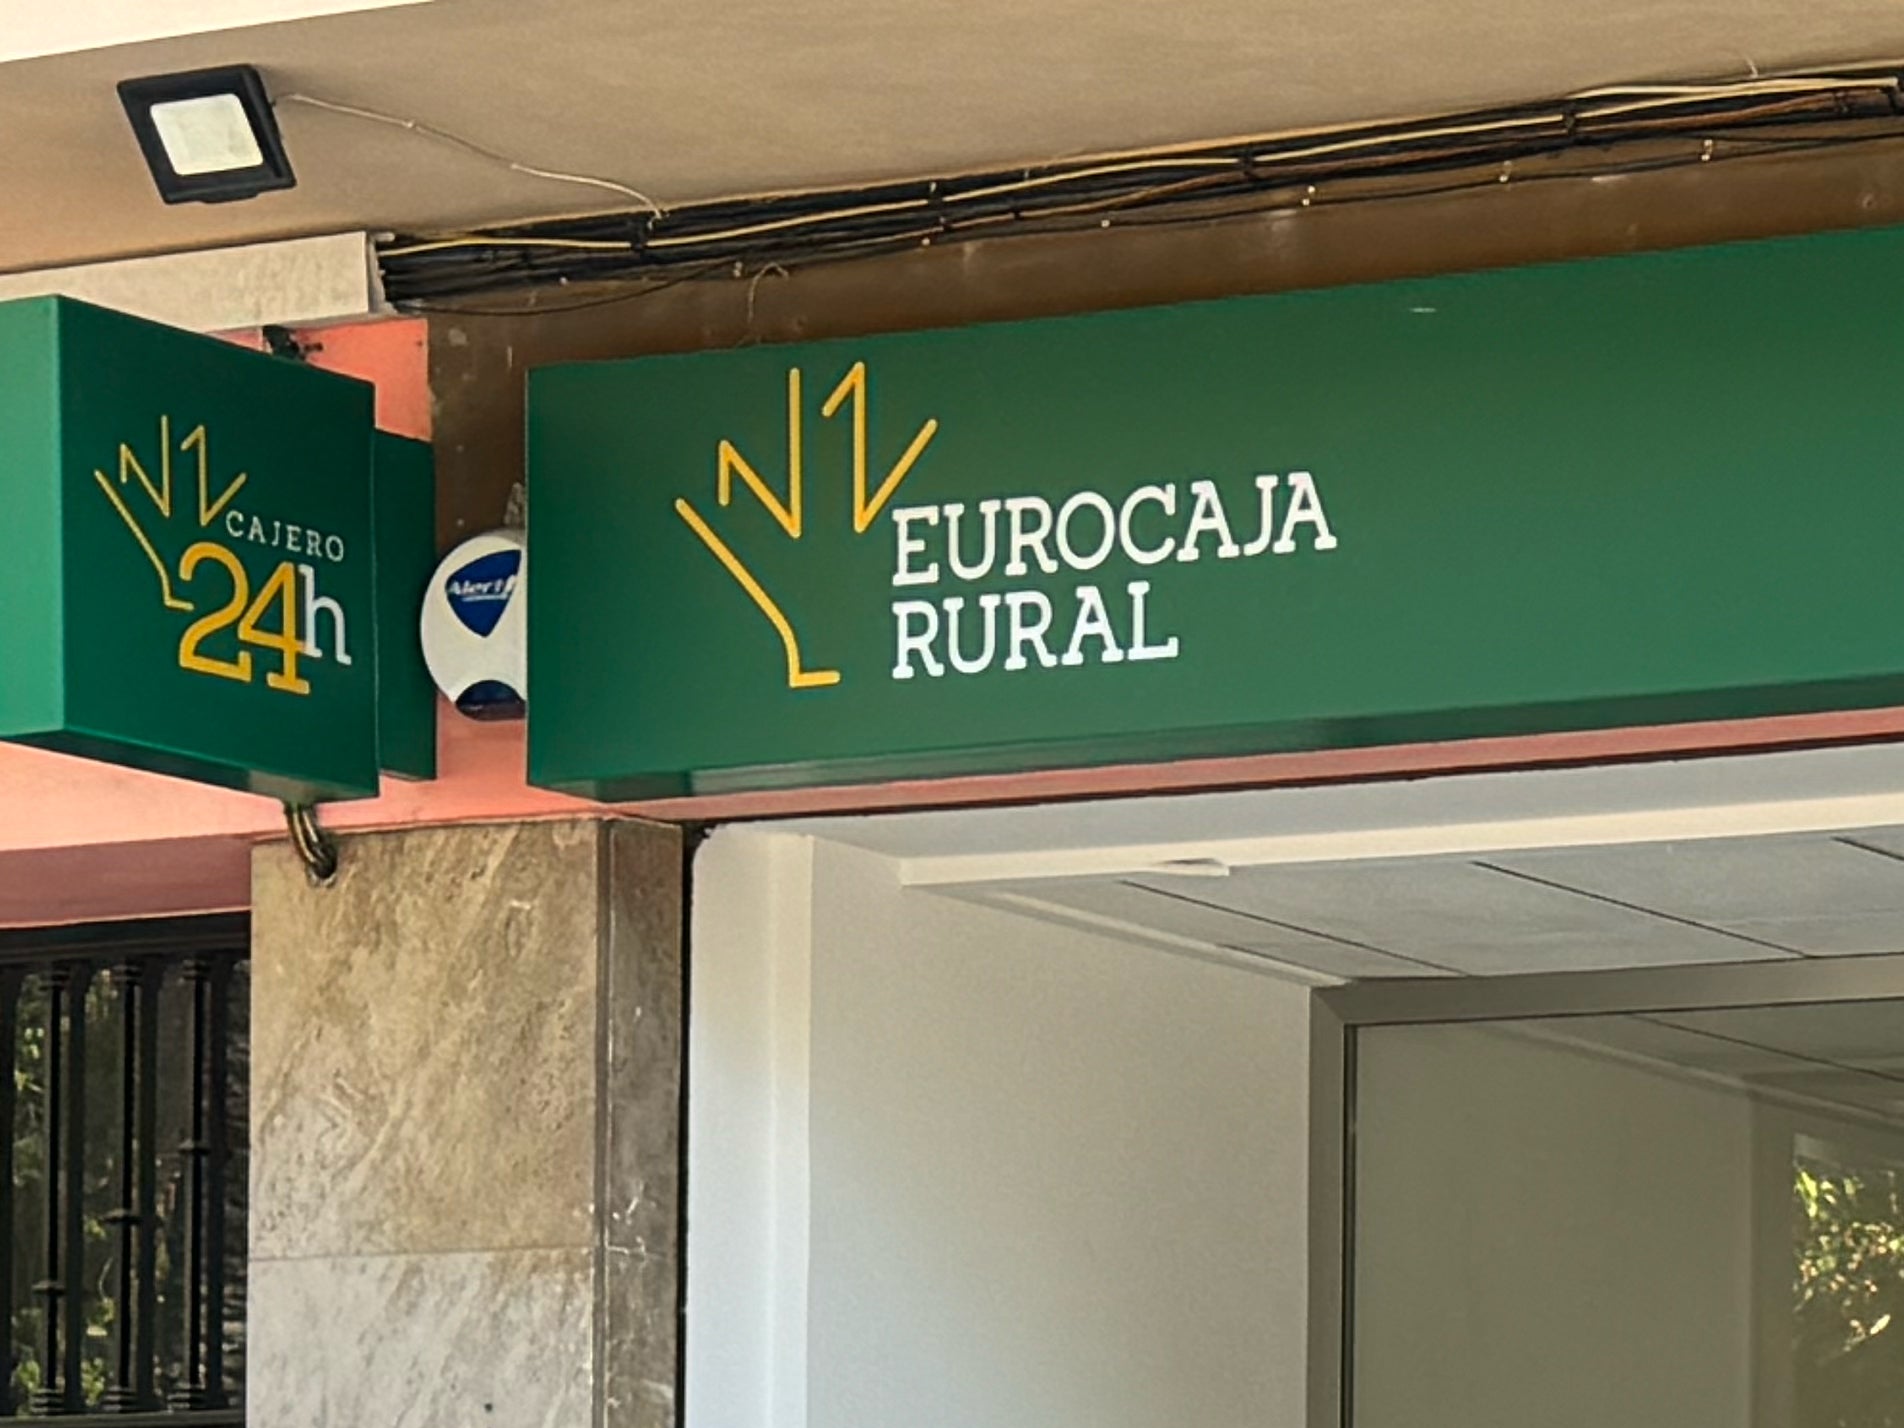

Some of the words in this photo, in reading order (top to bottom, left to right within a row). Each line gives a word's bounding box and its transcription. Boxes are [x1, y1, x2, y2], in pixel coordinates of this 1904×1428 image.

[225, 509, 345, 563] CAJERO
[891, 471, 1338, 587] EUROCAJA
[178, 541, 352, 696] 24h
[891, 580, 1180, 680] RURAL
